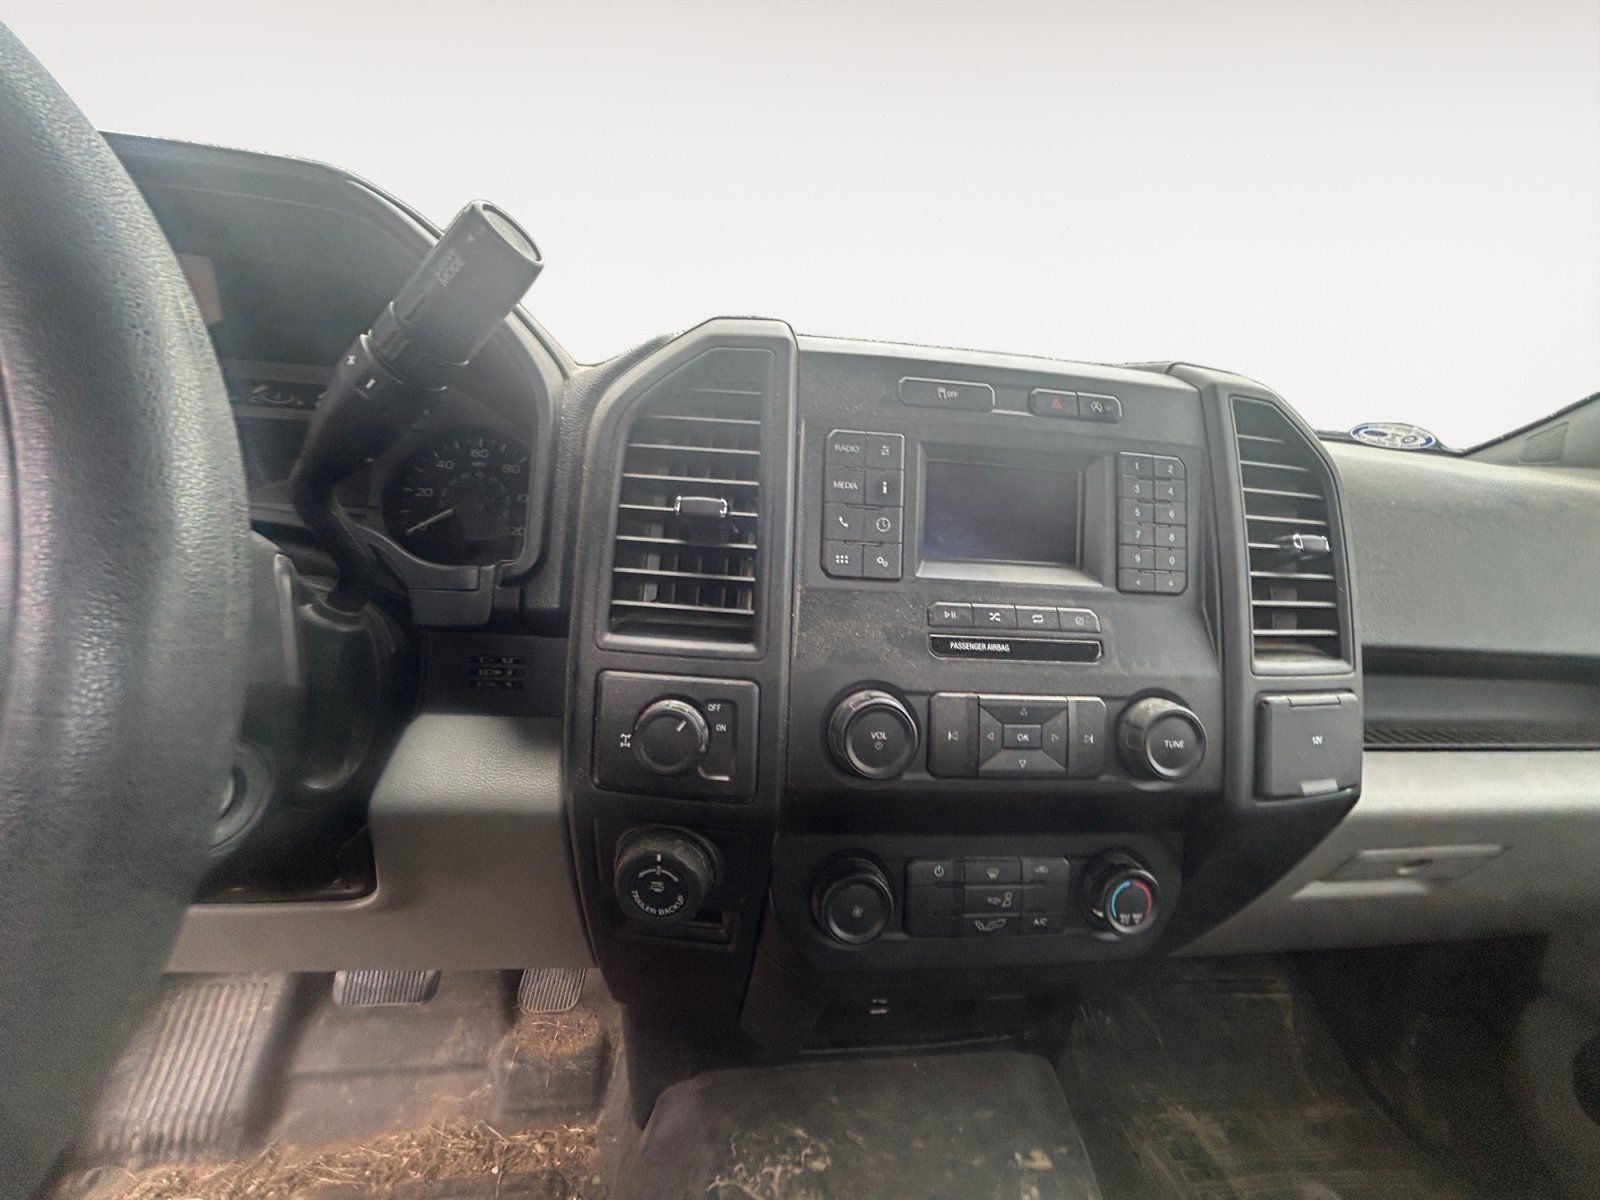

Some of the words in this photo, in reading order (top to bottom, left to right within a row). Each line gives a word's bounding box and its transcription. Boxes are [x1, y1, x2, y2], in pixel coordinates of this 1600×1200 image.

[470, 448, 489, 459] 60
[834, 443, 860, 454] RADIO
[436, 460, 455, 470] 40
[502, 463, 521, 474] 80
[1134, 461, 1140, 471] 1
[1167, 463, 1174, 475] 2
[832, 480, 859, 490] MEDIA
[1134, 483, 1141, 494] 3
[415, 487, 434, 498] 20
[1167, 486, 1174, 496] 4
[1134, 507, 1141, 517] 5
[1168, 508, 1175, 519] 6
[1135, 529, 1141, 539] 7
[1168, 532, 1175, 543] 8
[1134, 553, 1141, 563] 9
[1168, 555, 1176, 566] 0
[949, 641, 987, 651] PASSENGER
[986, 642, 1010, 653] AIRBAG
[707, 702, 722, 712] OFF
[715, 723, 727, 732] ON
[870, 730, 888, 741] VOL
[1016, 732, 1030, 743] OK
[1164, 739, 1185, 749] TUNE
[630, 888, 657, 916] TRAILER
[657, 894, 686, 916] BACKUP
